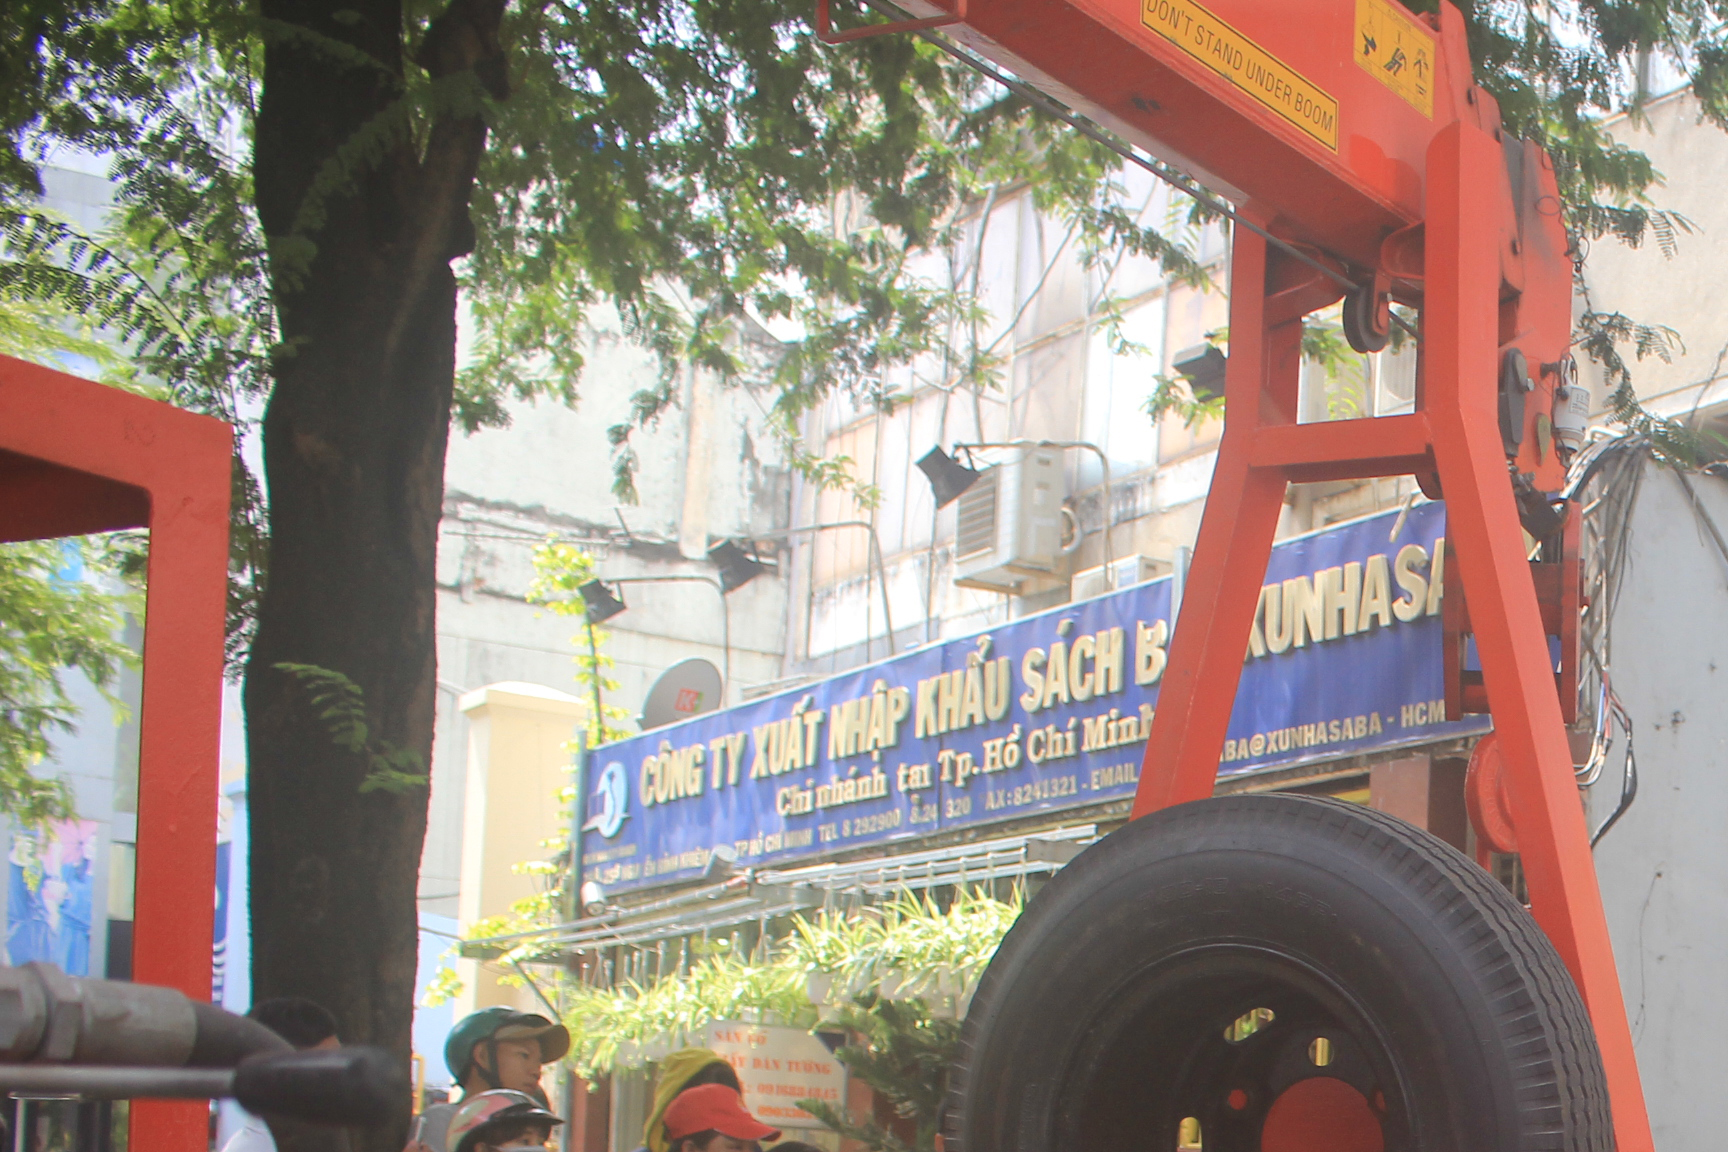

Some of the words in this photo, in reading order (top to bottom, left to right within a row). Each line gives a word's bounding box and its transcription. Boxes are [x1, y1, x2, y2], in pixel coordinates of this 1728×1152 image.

[1147, 0, 1194, 37] DON'T
[1195, 24, 1244, 71] STAND
[1245, 57, 1292, 106] UNDER
[1294, 93, 1333, 133] BOOM
[640, 739, 706, 808] CÔNG
[710, 730, 748, 790] TY
[750, 694, 826, 780] XUẤT
[828, 678, 911, 763] NHẬP
[914, 634, 1012, 738] KHẨU
[1020, 618, 1125, 714] SÁCH
[776, 778, 814, 818] Chi
[815, 765, 889, 811] nhánh
[1027, 716, 1078, 764] Chí
[1401, 699, 1446, 728] HCM
